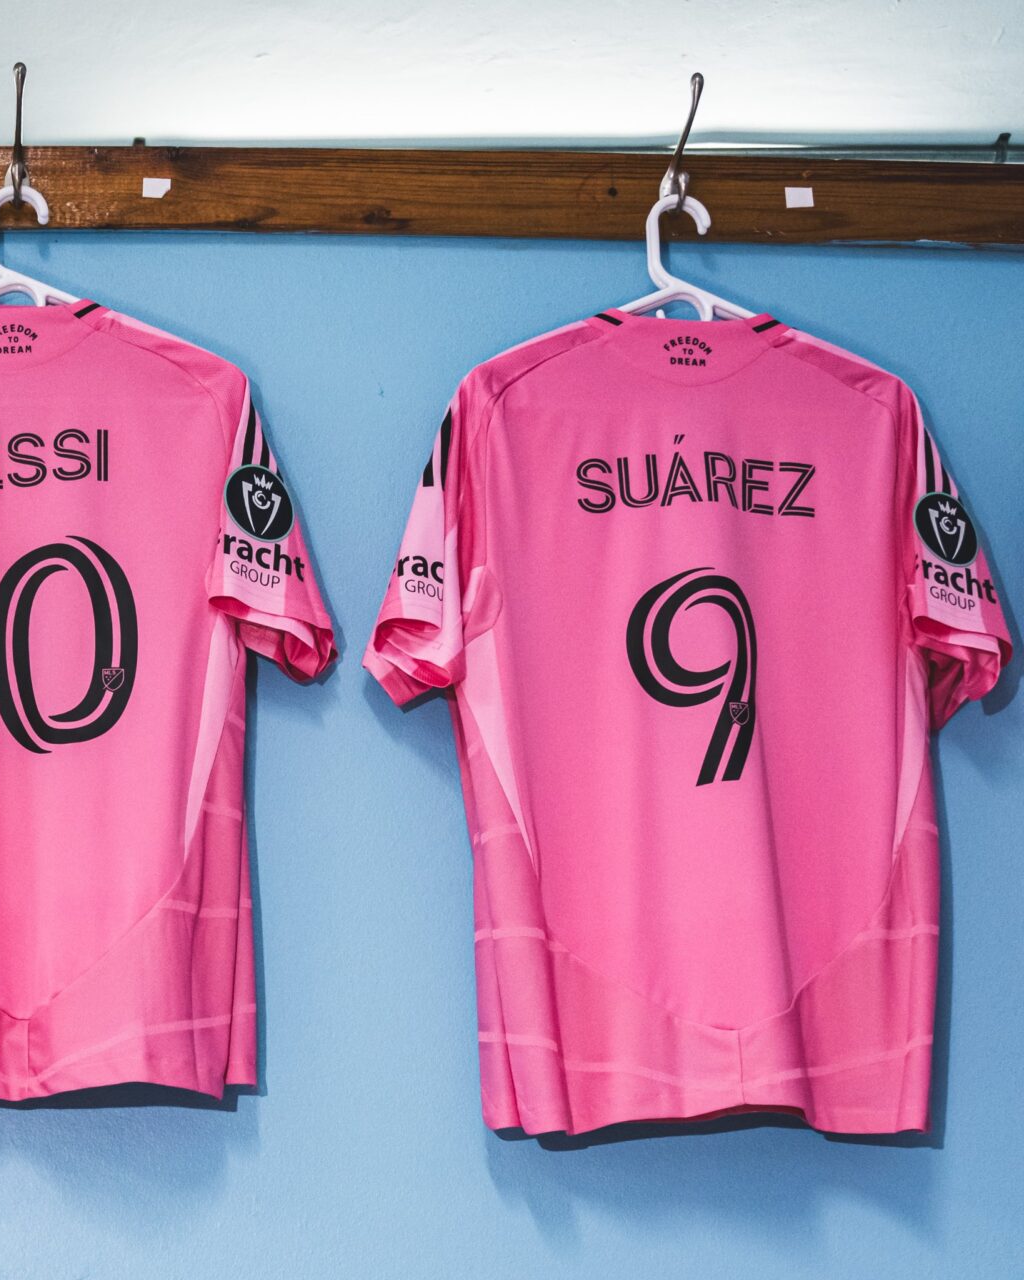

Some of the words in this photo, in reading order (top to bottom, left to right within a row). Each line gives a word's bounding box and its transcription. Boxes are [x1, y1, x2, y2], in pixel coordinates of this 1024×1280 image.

[663, 336, 712, 355] FREEDOM
[670, 357, 706, 366] DREAM
[576, 434, 816, 518] SUÁREZ
[219, 531, 305, 582] racht
[230, 560, 280, 588] GROUP
[919, 557, 996, 604] racht
[404, 579, 443, 601] GROU
[929, 586, 975, 610] GROUP
[626, 567, 757, 787] 9
